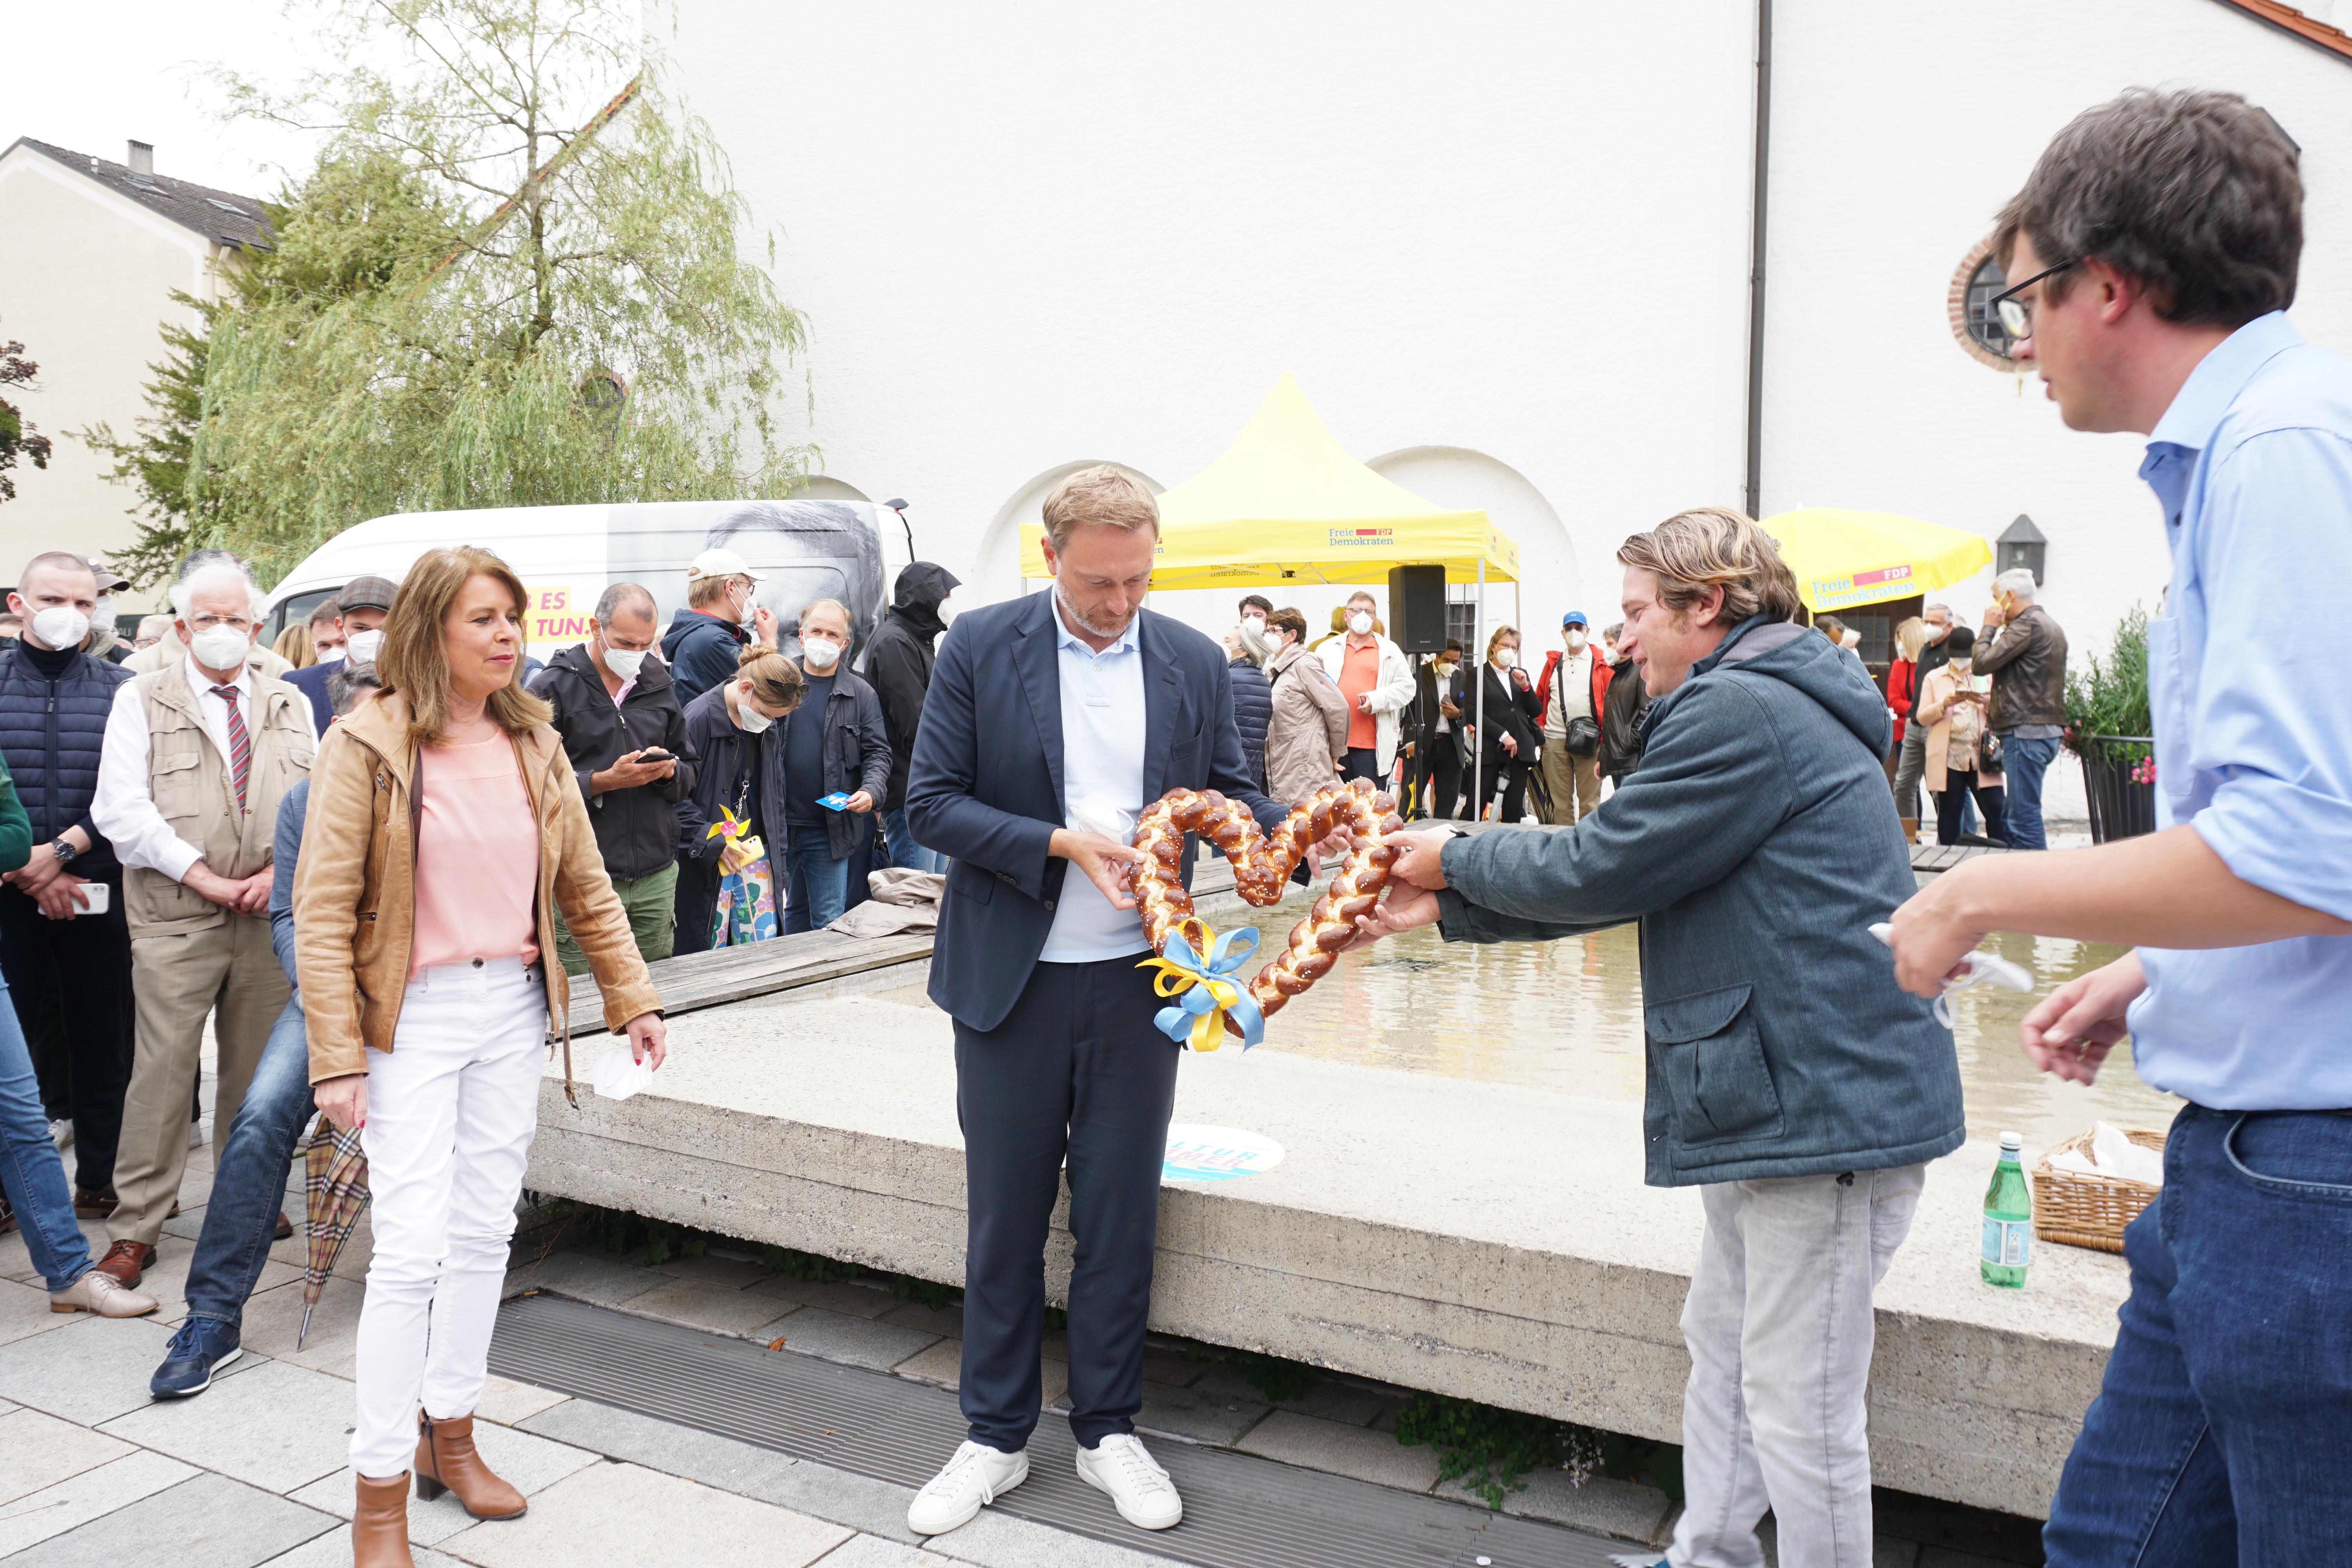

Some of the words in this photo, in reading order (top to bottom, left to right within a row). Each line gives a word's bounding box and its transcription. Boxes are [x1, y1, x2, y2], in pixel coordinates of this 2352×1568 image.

[1329, 528, 1354, 537] Freie
[1330, 537, 1394, 546] Demokraten
[1812, 577, 1851, 594] Freie
[1884, 567, 1908, 580] FDP
[540, 592, 566, 610] ES
[1815, 583, 1915, 608] Demokraten
[536, 617, 590, 636] TUN.
[1167, 1139, 1259, 1161] LTUR
